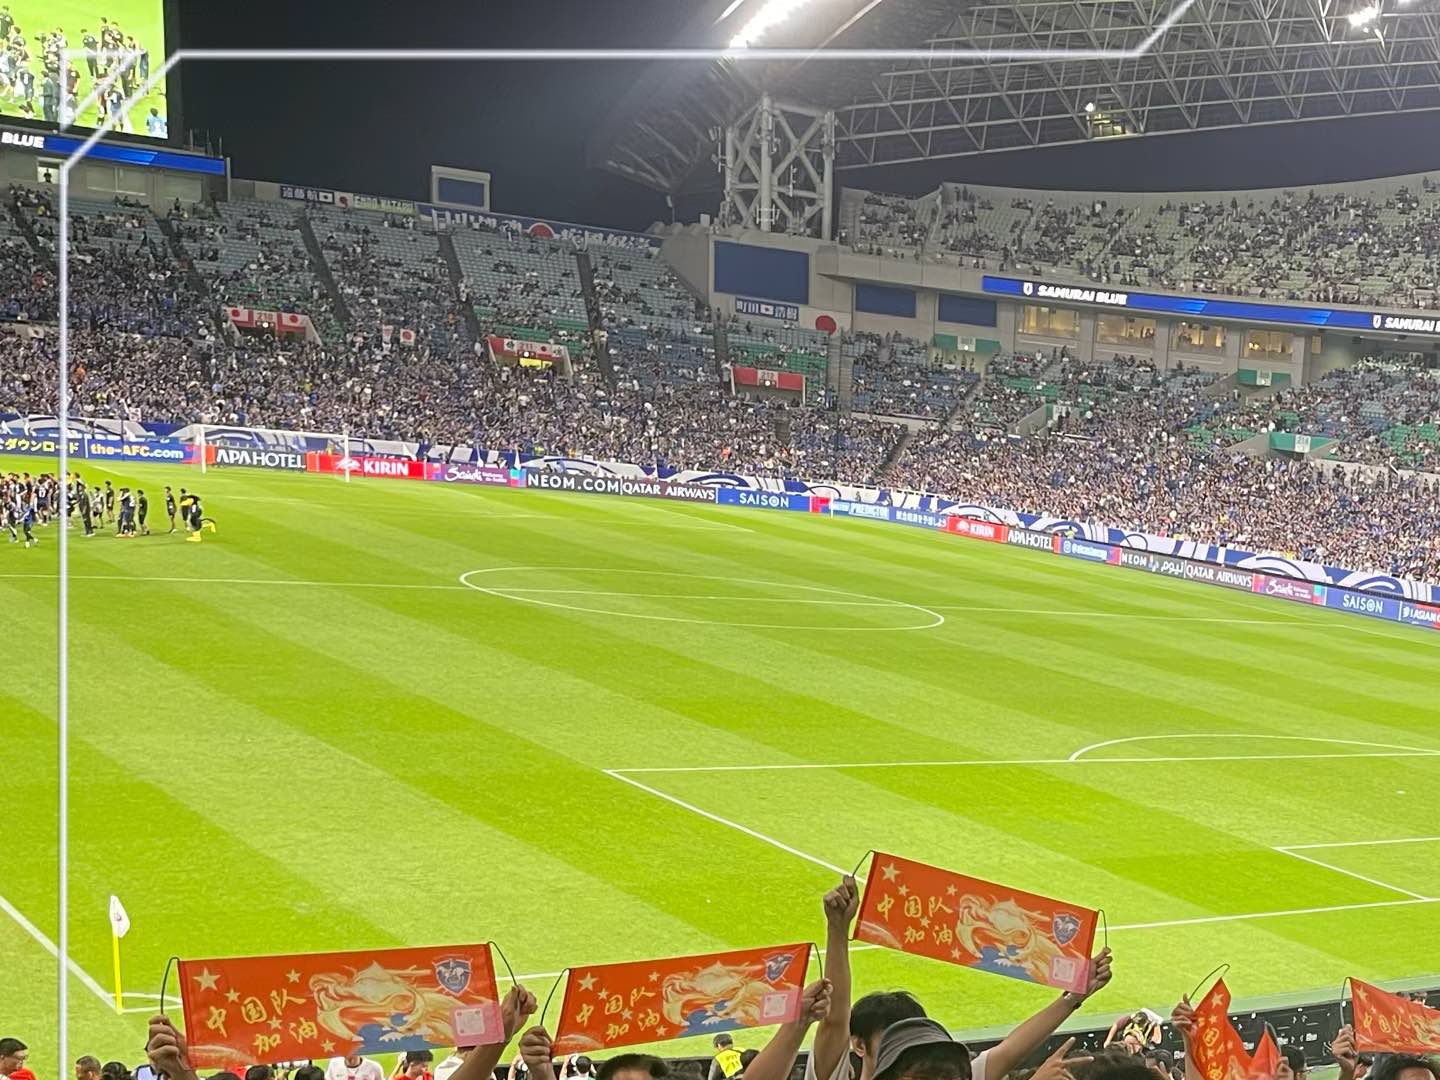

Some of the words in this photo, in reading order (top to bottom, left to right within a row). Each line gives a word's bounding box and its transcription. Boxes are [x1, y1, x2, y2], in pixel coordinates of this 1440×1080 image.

[1, 131, 45, 149] BLUE
[1037, 285, 1095, 302] SAMURAI
[1096, 291, 1127, 305] BLUE
[1384, 316, 1435, 332] SAMURAI
[91, 443, 184, 460] the-AFC.com
[216, 450, 250, 465] APA
[251, 452, 307, 469] HOTEL
[363, 458, 409, 476] KIRIN
[528, 473, 619, 493] NEOM.COM
[622, 482, 661, 495] QATAR
[666, 487, 715, 500] AIRWAYS
[739, 492, 790, 508] SAISON
[969, 523, 995, 537] KIRIN
[1007, 530, 1026, 544] APA
[1025, 533, 1054, 550] HOTEL
[1121, 553, 1147, 566] NEOM
[1186, 564, 1214, 580] QATAR
[1216, 571, 1252, 588] AIRWAYS
[1343, 594, 1384, 614] SAISON
[876, 893, 954, 922] 中国队
[903, 923, 953, 945] 加油
[207, 989, 306, 1038] 中国队
[576, 986, 656, 1027] 中国队
[605, 1009, 660, 1042] 加油
[252, 1017, 318, 1055] 加油
